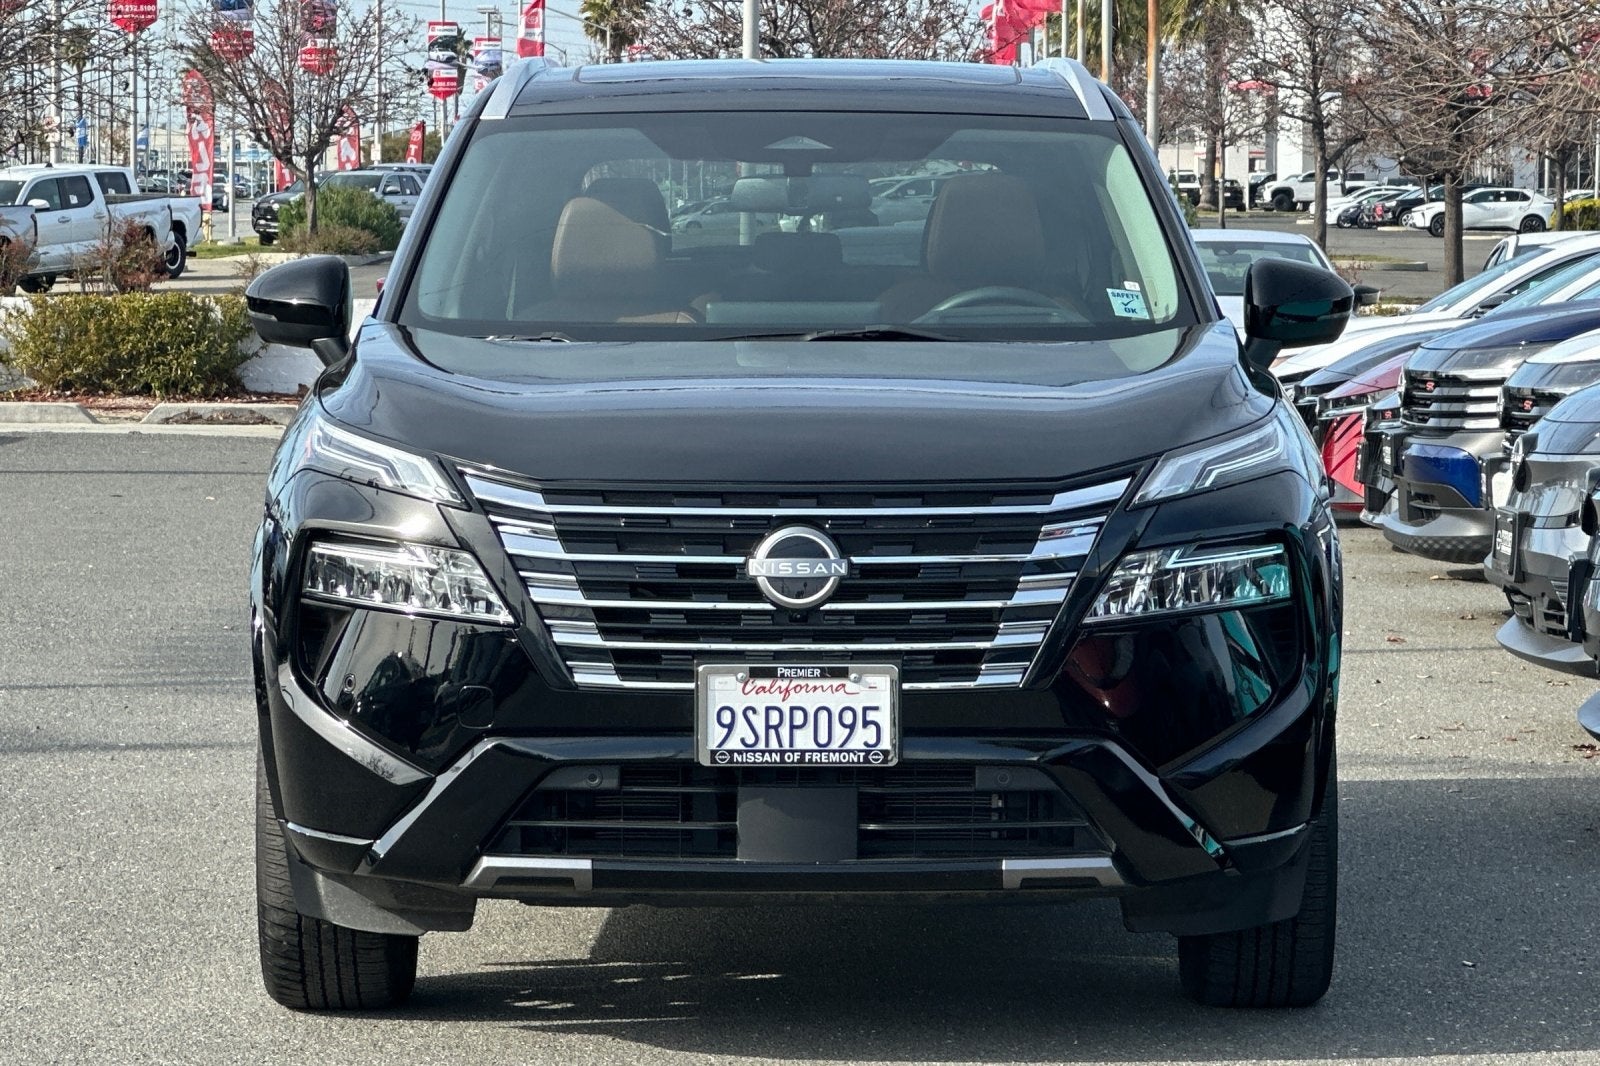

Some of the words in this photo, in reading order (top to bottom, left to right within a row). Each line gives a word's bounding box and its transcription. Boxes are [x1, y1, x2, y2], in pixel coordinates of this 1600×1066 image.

[1111, 292, 1139, 300] SAFETY
[752, 562, 847, 575] NISSAN
[741, 678, 860, 703] California
[715, 705, 882, 749] 9SRP095
[733, 752, 780, 763] NISSAN
[784, 752, 802, 763] OF
[805, 752, 866, 763] FREMONT
